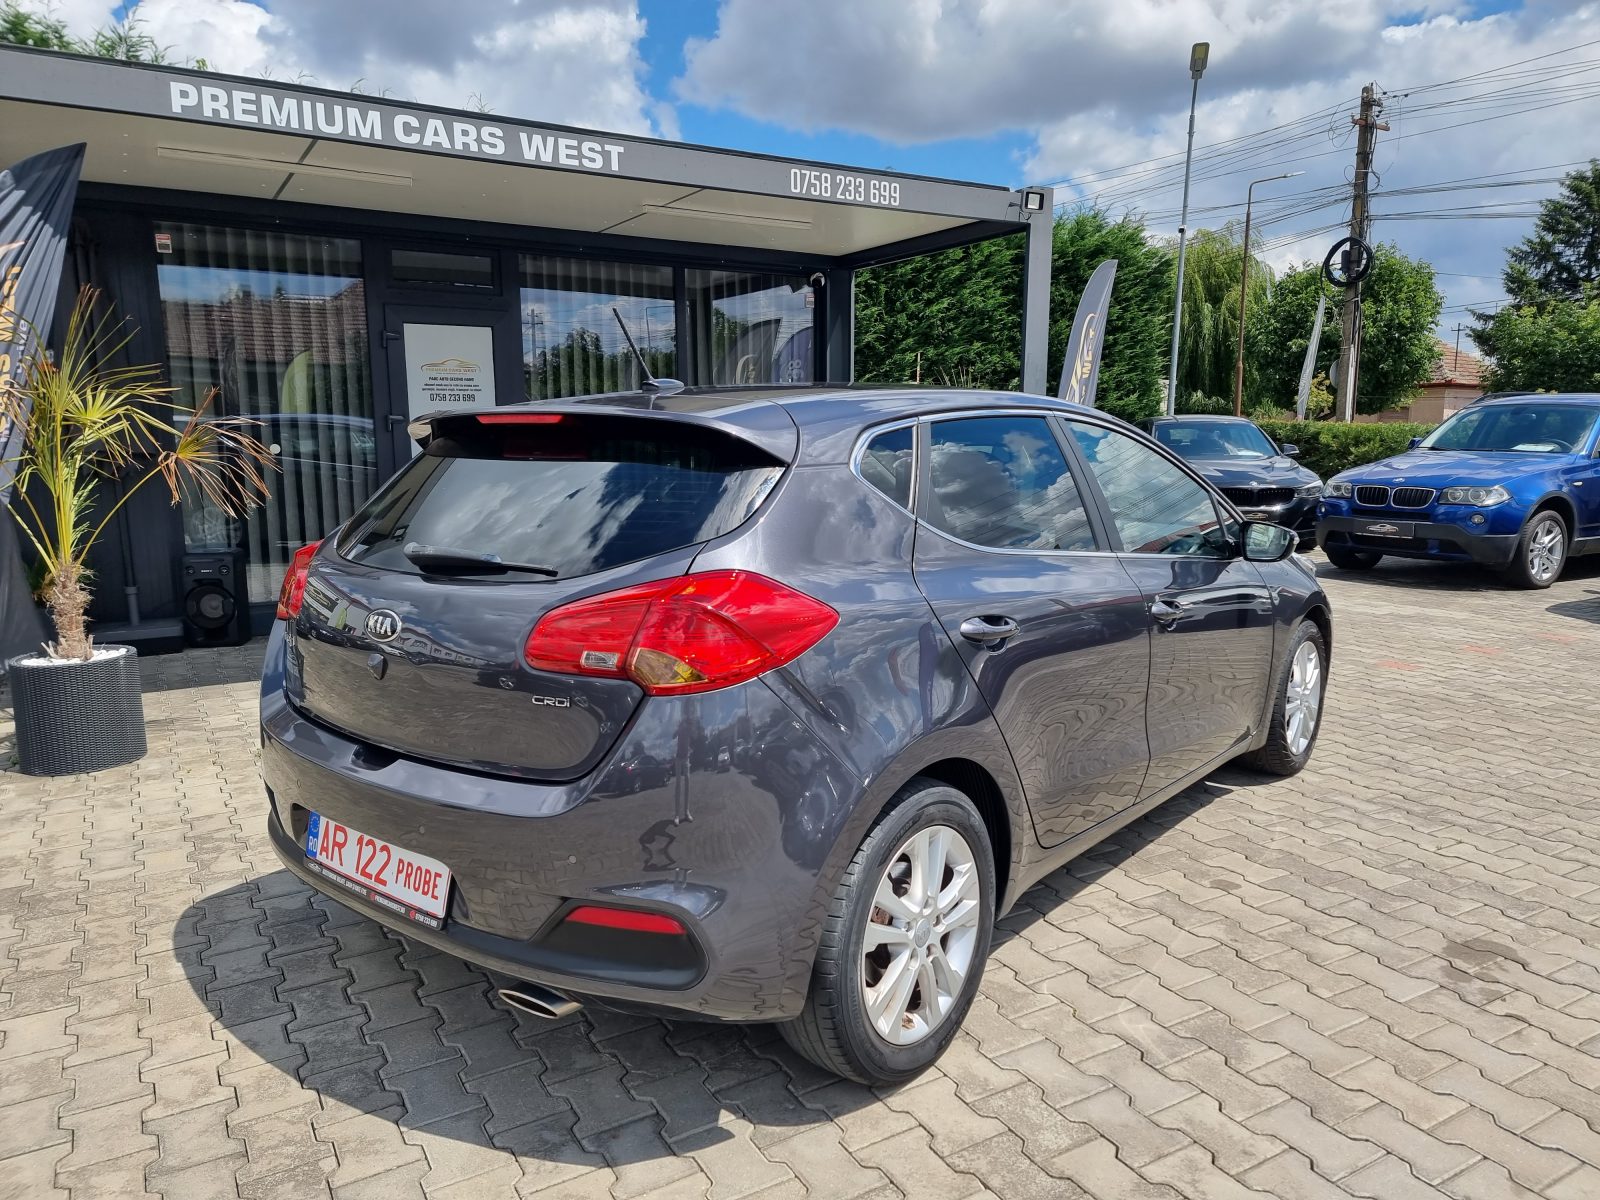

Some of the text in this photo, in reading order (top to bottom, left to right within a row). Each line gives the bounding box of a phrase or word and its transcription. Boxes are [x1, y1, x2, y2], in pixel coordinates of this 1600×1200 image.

[169, 81, 625, 171] PREMIUM CARS WEST
[790, 168, 900, 206] 0758 233 699
[430, 393, 476, 402] 0758 233 699
[367, 614, 392, 636] KIA
[532, 695, 570, 707] CRDi
[308, 836, 318, 852] RO
[319, 820, 348, 866] AR
[355, 834, 391, 887] 122
[395, 858, 442, 900] PROBE
